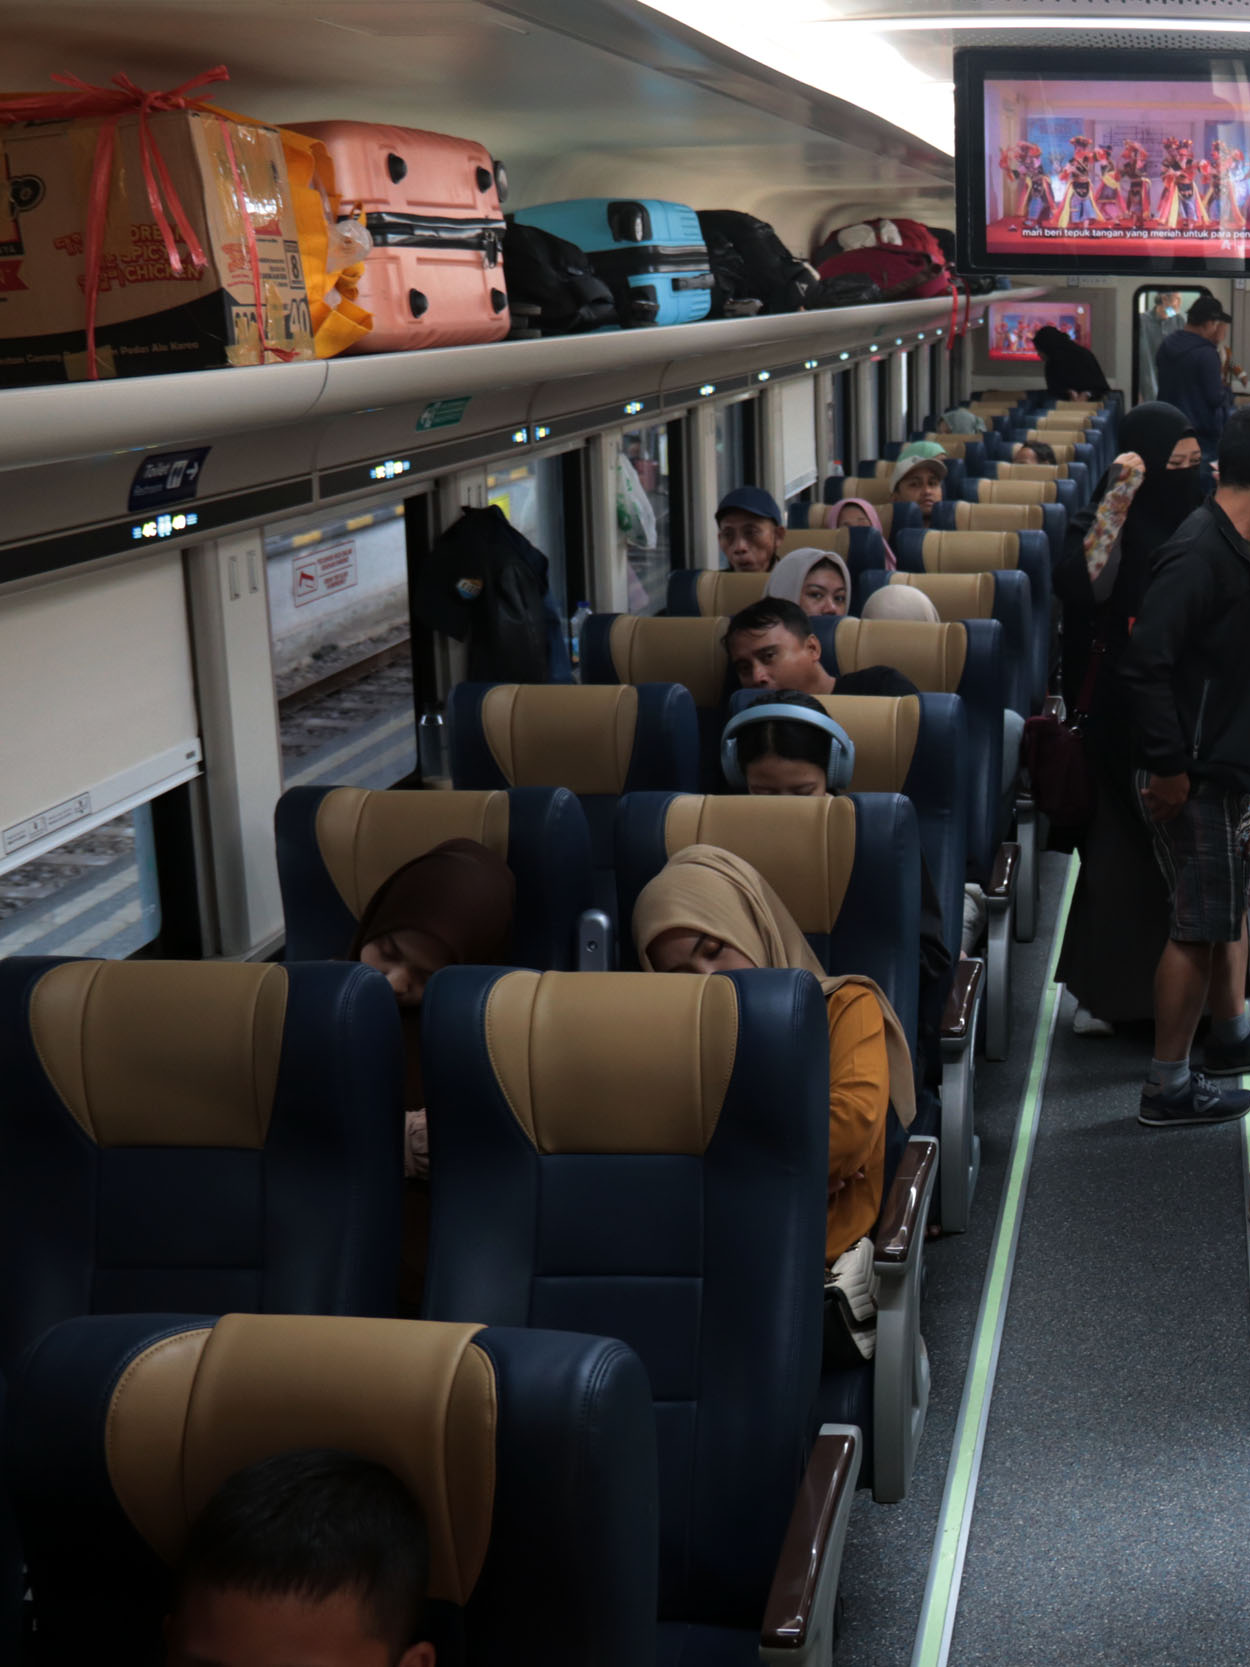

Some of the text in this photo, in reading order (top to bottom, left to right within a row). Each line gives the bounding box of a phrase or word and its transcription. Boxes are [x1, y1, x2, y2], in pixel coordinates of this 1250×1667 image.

[1044, 228, 1062, 237] beri
[1064, 228, 1090, 238] tepuk
[1092, 229, 1123, 239] tangan
[1126, 229, 1148, 239] yang
[1150, 229, 1181, 238] meriah
[1183, 230, 1209, 239] untuk
[1210, 231, 1231, 240] para
[289, 253, 301, 280] 8
